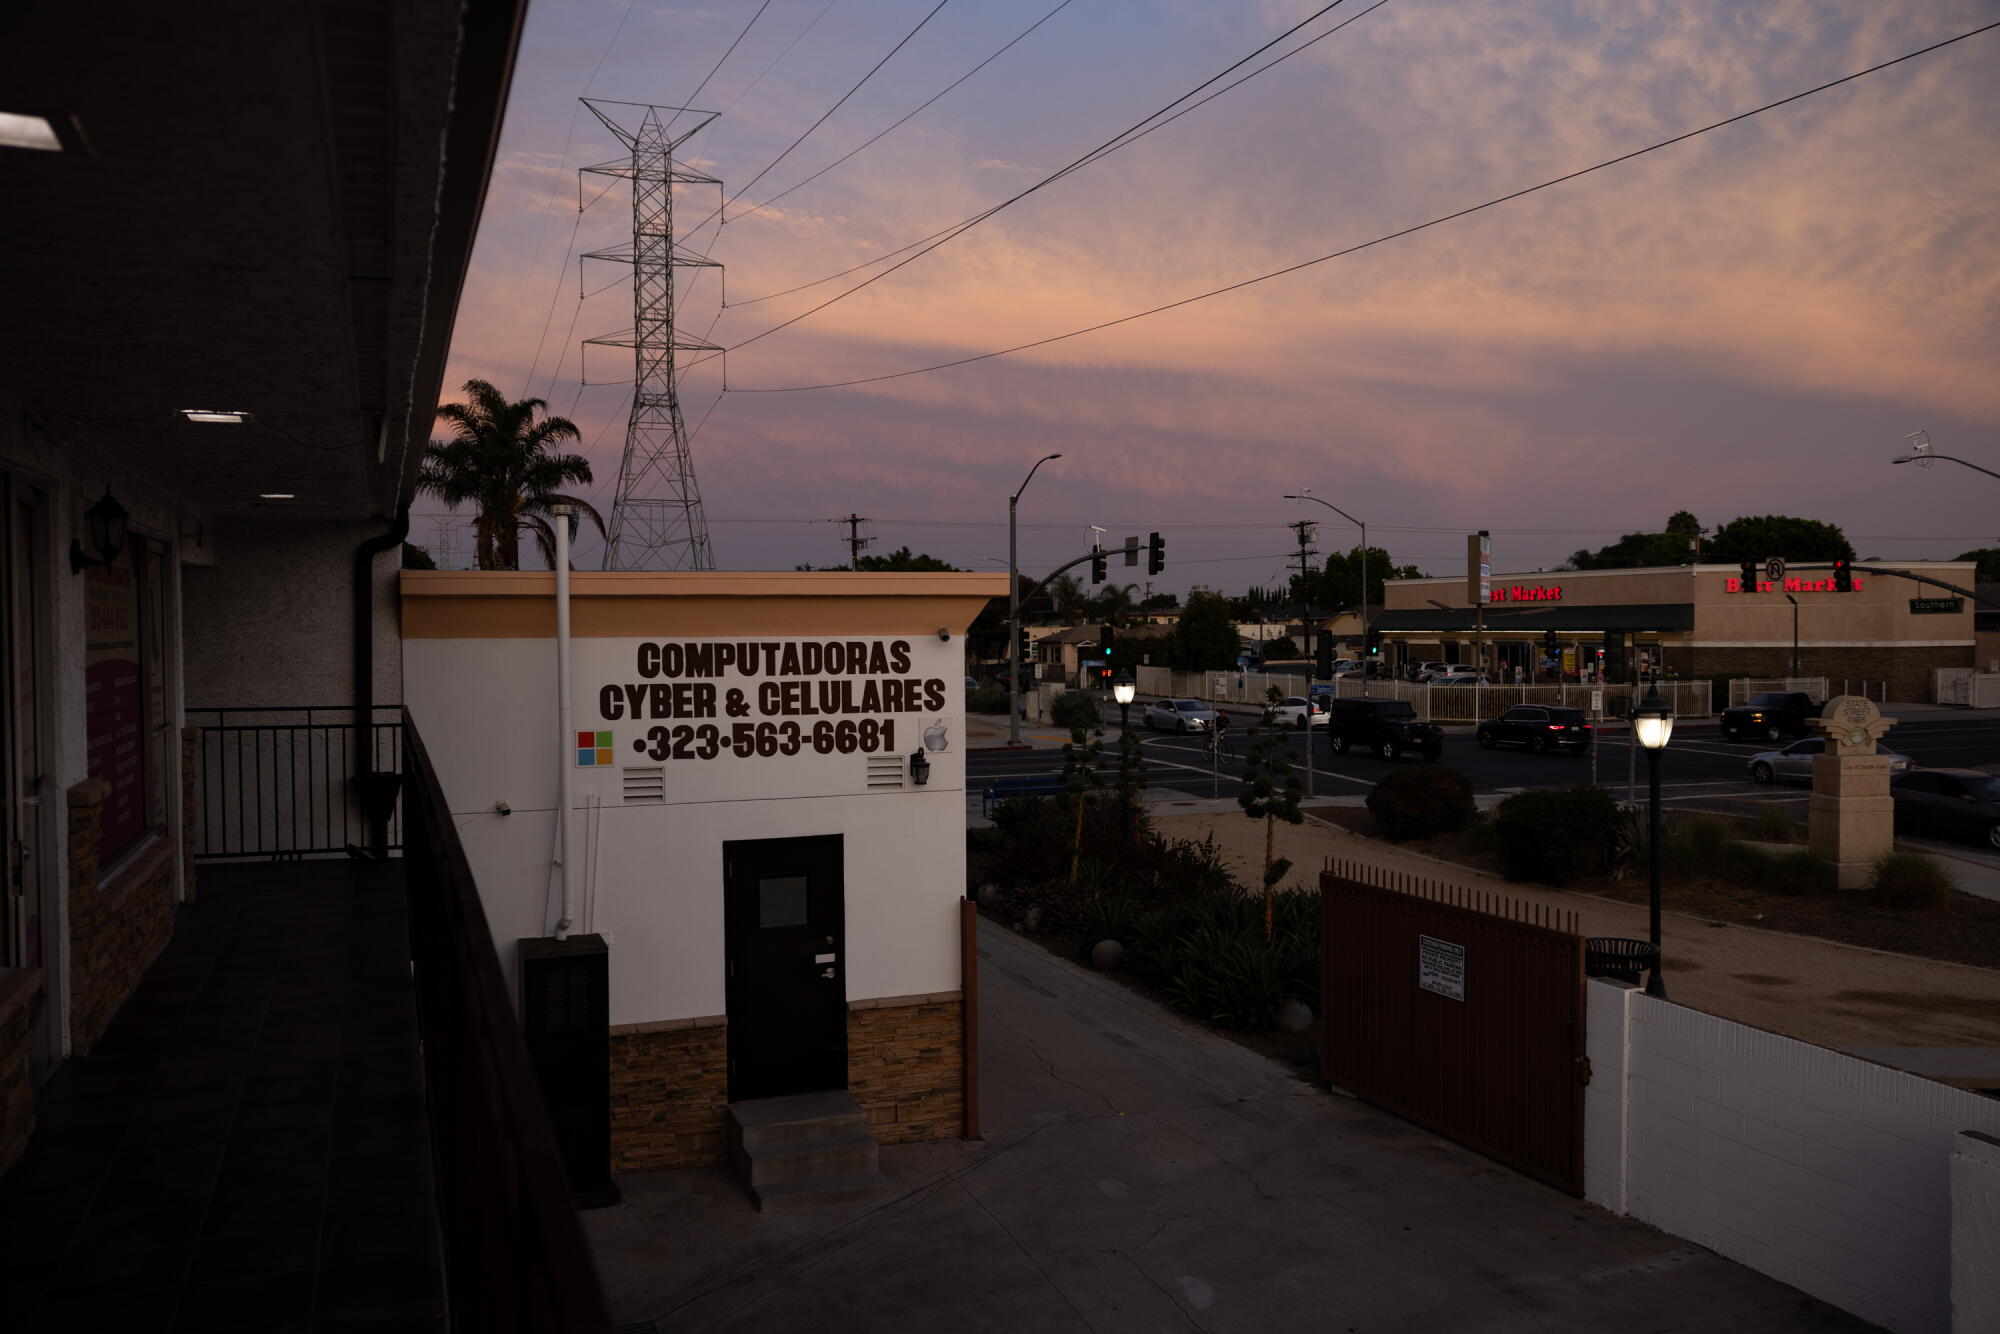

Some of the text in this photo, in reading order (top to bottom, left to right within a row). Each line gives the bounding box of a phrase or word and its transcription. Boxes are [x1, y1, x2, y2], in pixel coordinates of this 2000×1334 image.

[1726, 577, 1865, 592] Bst Markt
[1510, 585, 1562, 602] Market
[1914, 601, 1955, 609] Southern
[637, 639, 912, 679] COMPUTADORAS
[599, 678, 946, 721] CYBER & CELULARES
[1846, 700, 1868, 708] STATE
[1843, 708, 1872, 717] STREET
